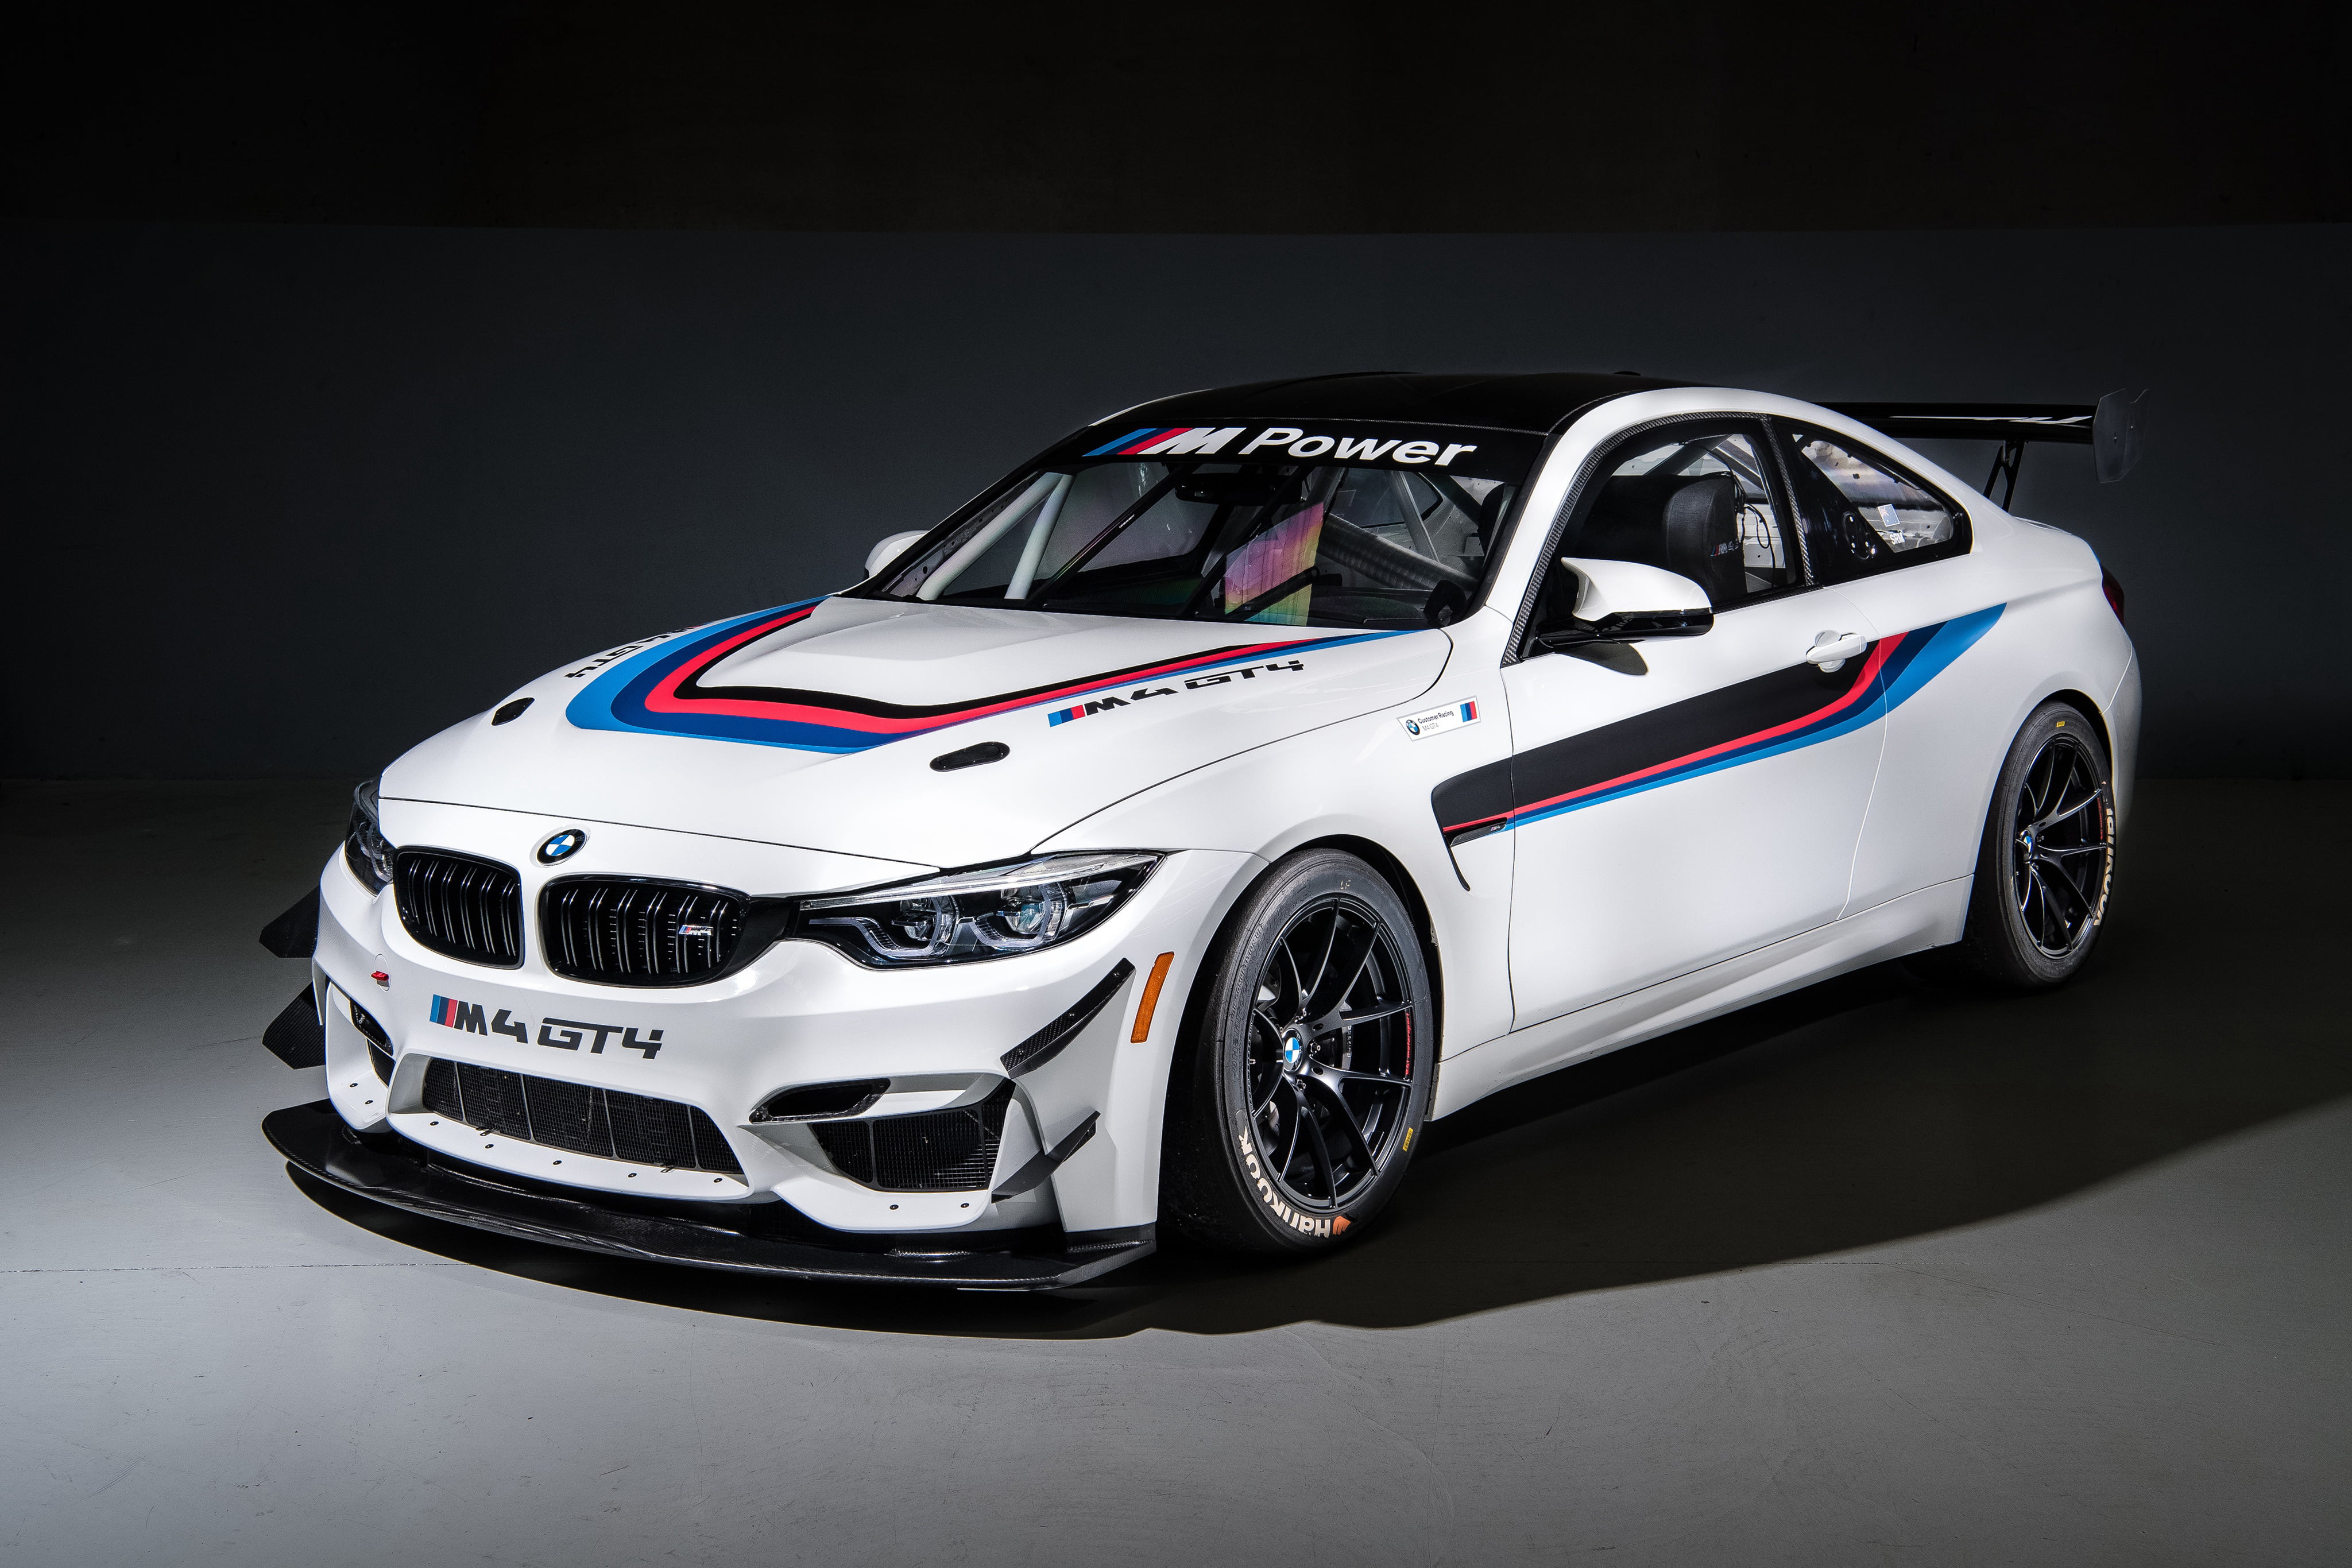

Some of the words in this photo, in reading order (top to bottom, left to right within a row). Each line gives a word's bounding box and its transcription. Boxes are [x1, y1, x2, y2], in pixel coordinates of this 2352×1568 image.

[1138, 427, 1247, 454] M
[1238, 427, 1477, 467] Power
[1889, 532, 1905, 545] SRM
[1084, 687, 1179, 717] M4
[1184, 660, 1304, 690] GT4
[1418, 714, 1438, 724] Customer
[1438, 710, 1454, 718] Racing
[454, 1000, 529, 1044] M4
[537, 1017, 664, 1059] GT4
